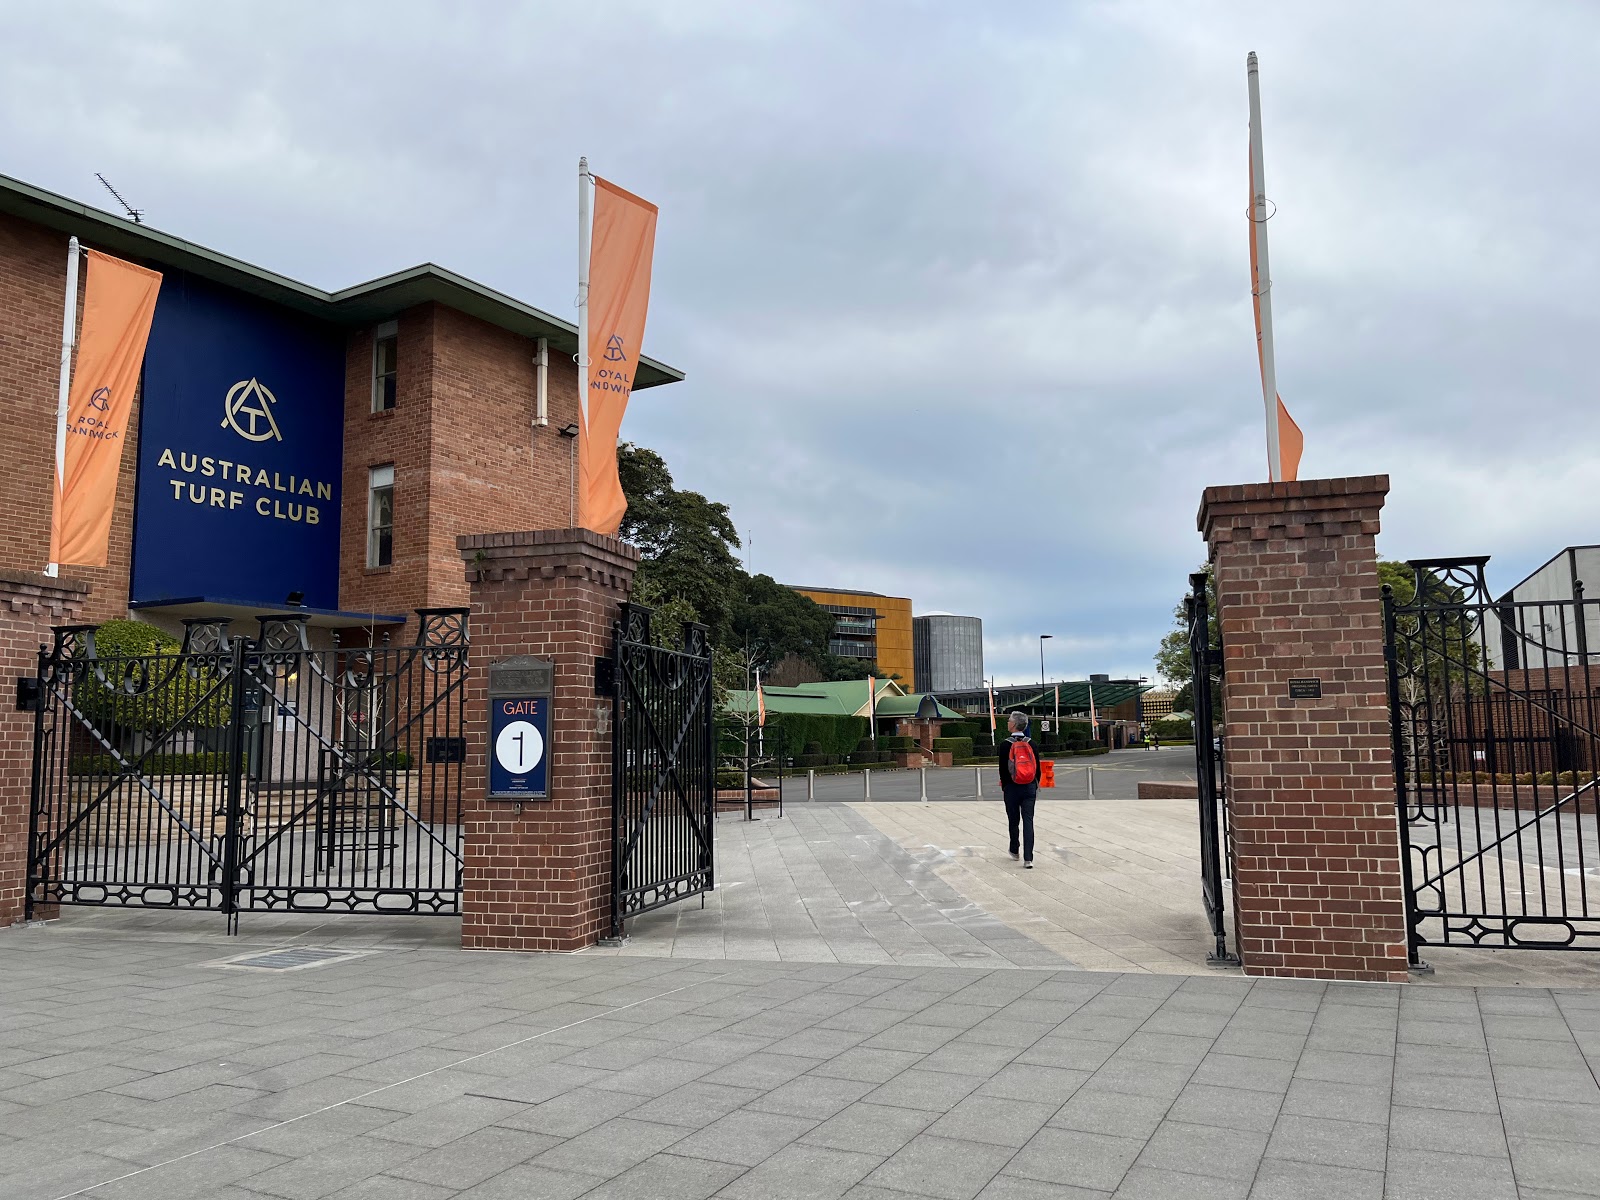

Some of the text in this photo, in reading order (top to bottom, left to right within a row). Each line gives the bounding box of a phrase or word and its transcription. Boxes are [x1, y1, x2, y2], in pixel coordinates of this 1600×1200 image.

[596, 369, 630, 383] OYAL
[157, 448, 332, 500] AUSTRALIAN
[170, 479, 320, 525] TURF CLUB
[503, 701, 538, 715] GATE
[512, 731, 523, 766] 1
